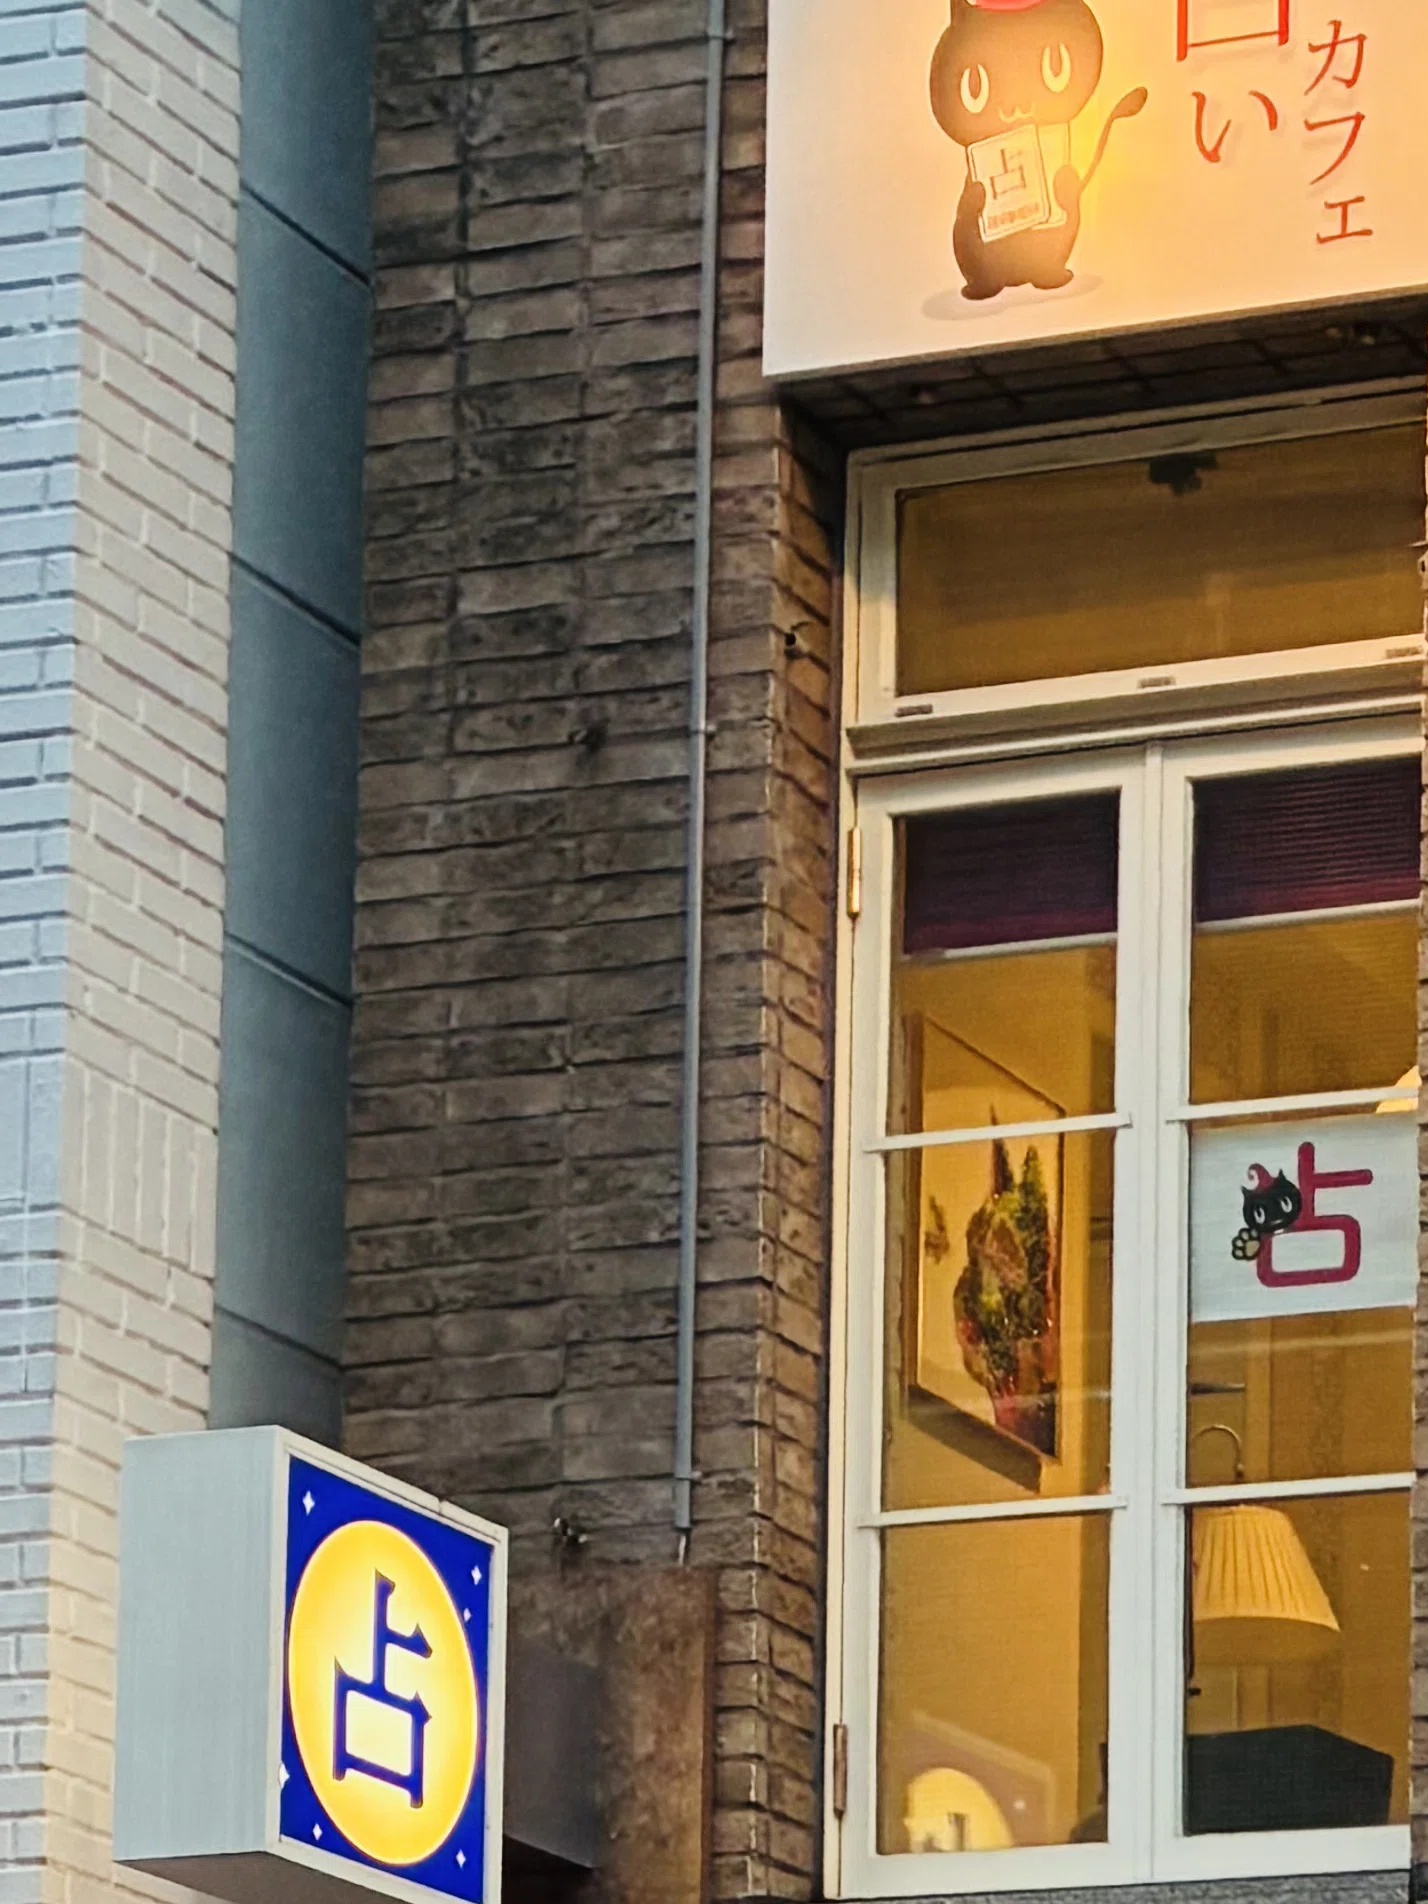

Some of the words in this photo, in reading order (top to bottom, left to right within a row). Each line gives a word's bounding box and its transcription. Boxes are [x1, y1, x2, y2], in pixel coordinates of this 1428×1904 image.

[1175, 0, 1291, 164] い
[1303, 19, 1374, 245] カフェ
[1255, 1141, 1374, 1289] 占
[332, 1567, 433, 1810] 占
